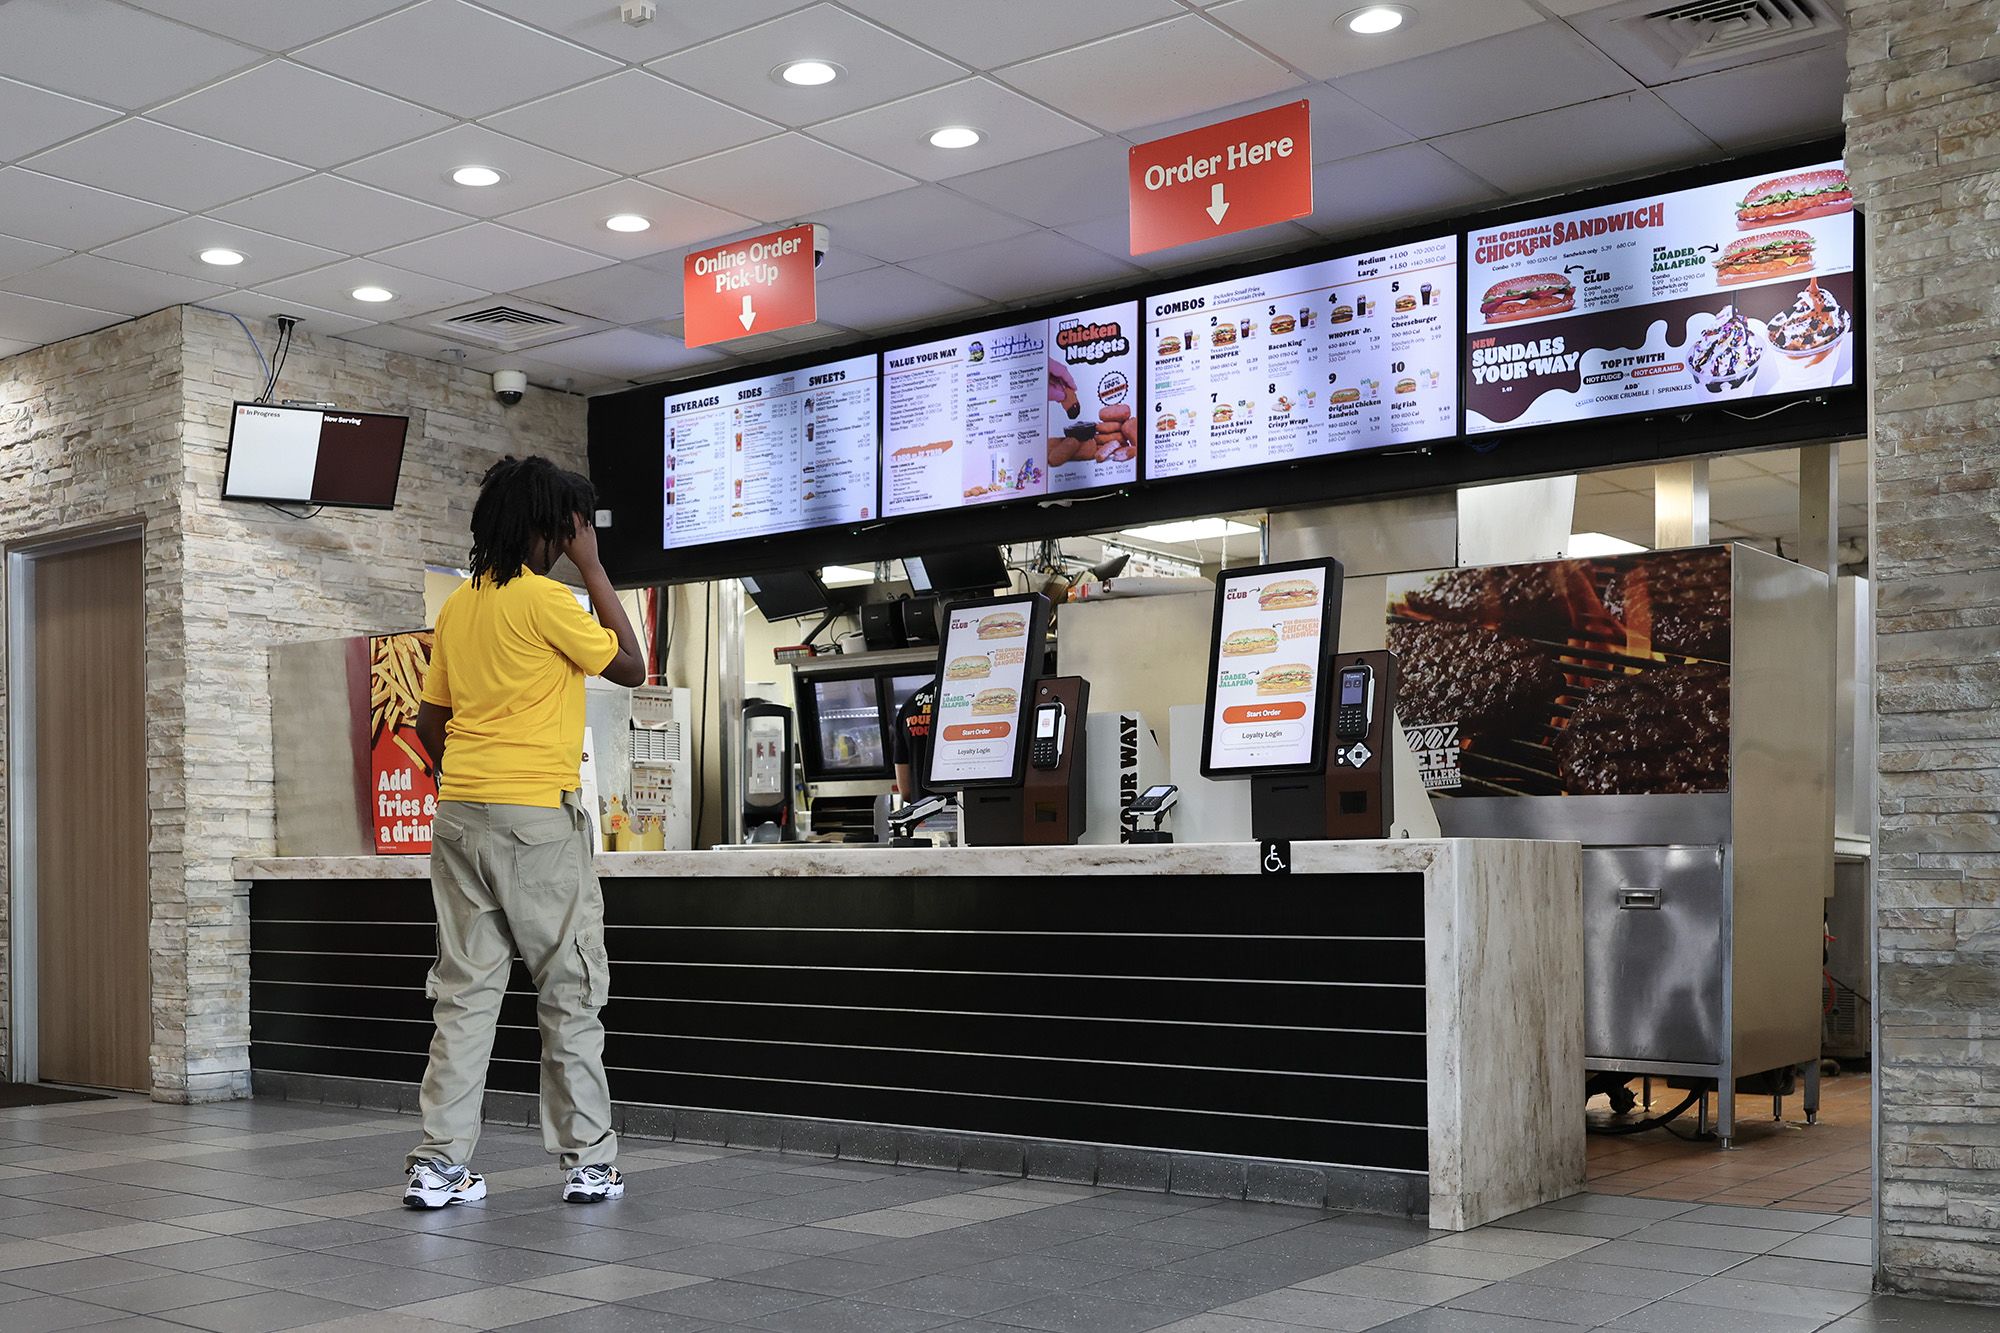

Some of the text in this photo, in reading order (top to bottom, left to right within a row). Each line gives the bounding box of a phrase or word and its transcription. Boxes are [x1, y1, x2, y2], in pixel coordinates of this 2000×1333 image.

[1144, 137, 1294, 190] Order Here
[1475, 202, 1664, 264] CHICKEN SANDWICH
[1478, 224, 1552, 246] THE ORIGINAL
[695, 237, 801, 276] Online Order
[1563, 250, 1586, 258] Sandwich
[1653, 248, 1694, 262] LOADED
[1358, 255, 1386, 266] Medium
[1650, 254, 1706, 272] JALAPEÑO
[716, 264, 778, 293] Pick-Up
[1358, 268, 1378, 277] Large
[1583, 272, 1610, 284] CLUB
[1652, 273, 1670, 281] Combo
[1392, 281, 1400, 292] 5
[1652, 284, 1676, 292] Sandwich
[1328, 292, 1338, 304] 4
[1155, 297, 1205, 316] COMBOS
[1268, 305, 1276, 316] 3
[1060, 320, 1079, 331] NEW
[1210, 316, 1218, 327] 2
[1392, 316, 1438, 328] Cheeseburger
[1058, 324, 1118, 346] Chicken
[1156, 328, 1160, 338] 1
[1067, 338, 1125, 360] Nuggets
[1268, 340, 1302, 350] Bacon King
[1472, 337, 1496, 349] NEW
[1472, 336, 1564, 367] SUNDAES
[890, 348, 958, 368] VALUE YOUR WAY
[1601, 352, 1666, 370] TOP IT WITH
[1391, 361, 1406, 374] 10
[1472, 351, 1580, 385] YOUR WAY
[808, 370, 846, 386] SWEETS
[1328, 373, 1336, 384] 9
[1586, 364, 1680, 384] HOT FUDGE HOT CARAMEL
[738, 386, 762, 400] SIDES
[1268, 383, 1276, 394] 8
[1596, 384, 1692, 402] COOKIE CRUMBLE SPRINKLES
[1211, 393, 1218, 403] 7
[1403, 400, 1416, 408] Fish
[671, 396, 720, 414] BEVERAGES
[1155, 402, 1162, 412] 6
[1328, 400, 1382, 412] Original Chicken
[254, 410, 280, 418] Progress
[1273, 413, 1290, 421] Royal
[1328, 410, 1359, 420] Sandwich
[338, 416, 362, 426] Serving
[1154, 430, 1190, 440] Royal Crispy
[1210, 428, 1248, 438] Royal Crispy
[1227, 592, 1248, 600] CLUB
[952, 622, 968, 630] CLUB
[1282, 622, 1319, 634] CHICKEN
[1282, 630, 1319, 640] SANDWICH
[1246, 708, 1281, 718] Start Order
[962, 728, 991, 736] Start Order
[1242, 730, 1282, 740] Loyalty Login
[958, 746, 990, 756] Loyalty Login
[378, 768, 412, 791] Add
[1120, 715, 1138, 844] YOUR WAY
[378, 793, 438, 816] fries &
[380, 826, 391, 842] a
